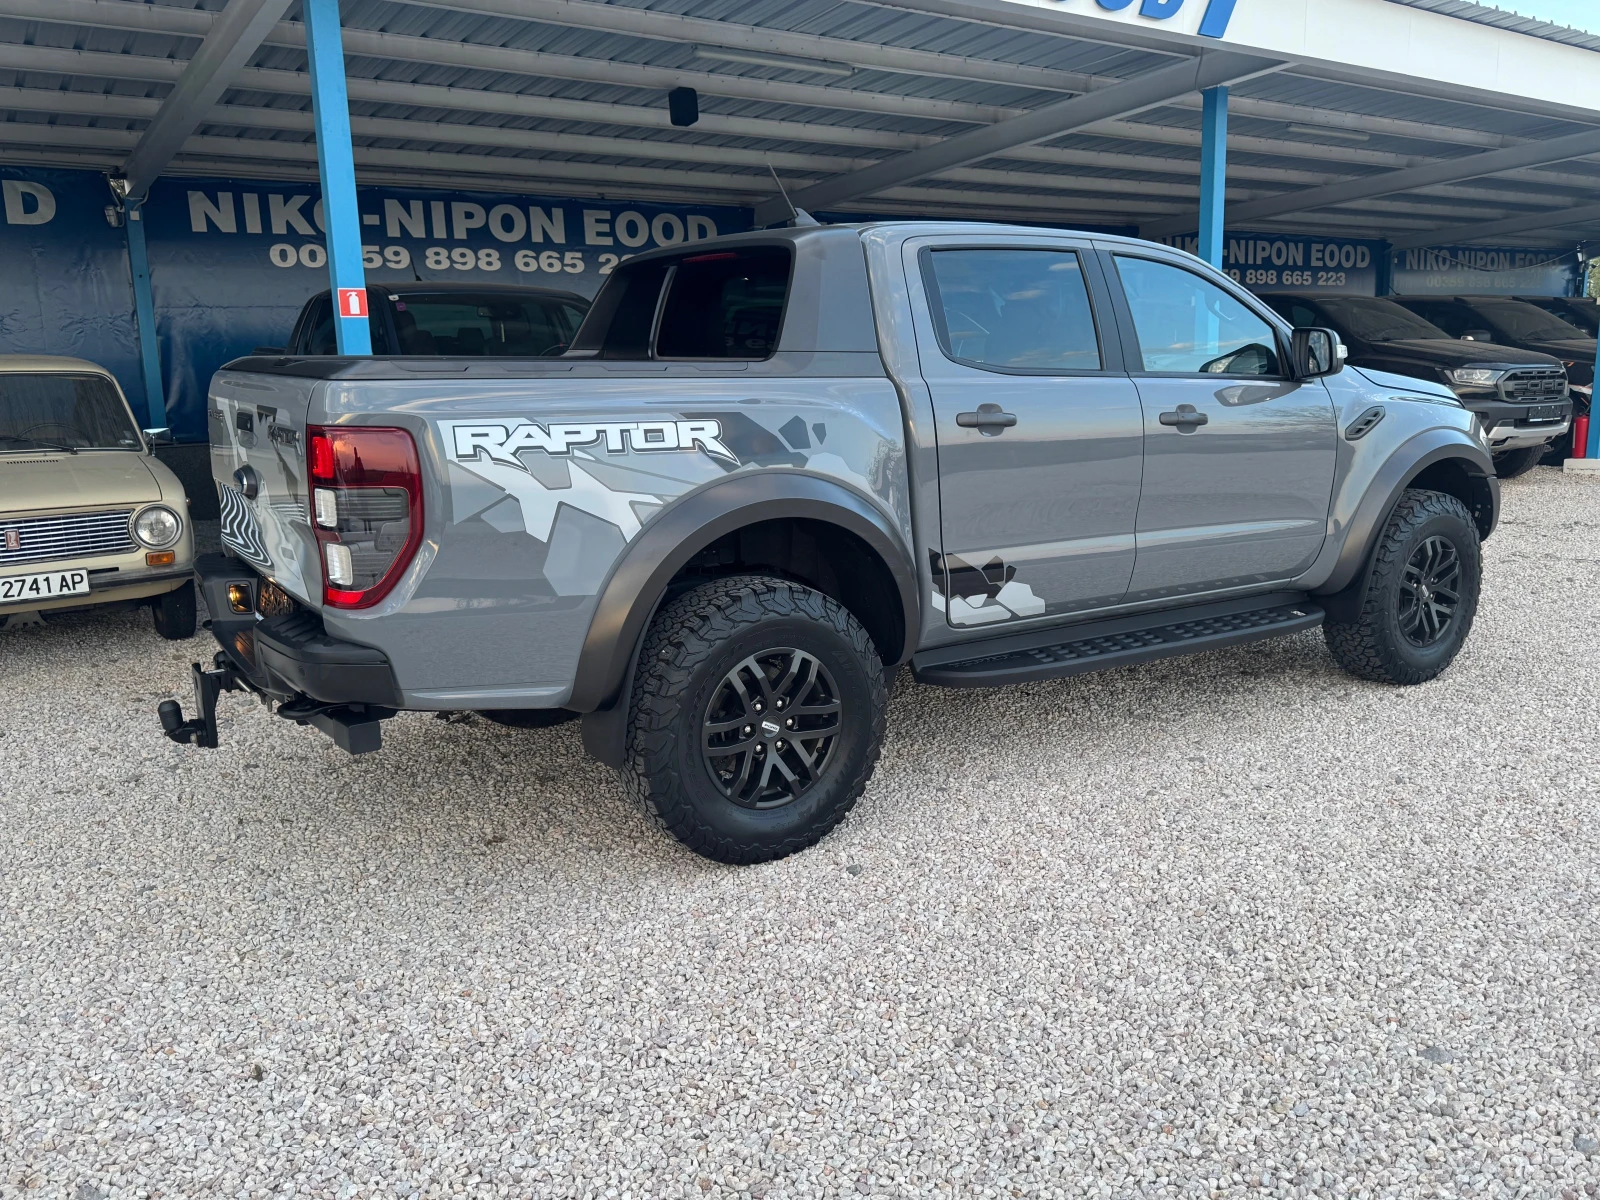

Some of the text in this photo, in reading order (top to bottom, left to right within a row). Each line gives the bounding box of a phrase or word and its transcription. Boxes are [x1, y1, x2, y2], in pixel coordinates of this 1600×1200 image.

[583, 209, 718, 247] EOOD
[269, 244, 411, 269] 0059
[425, 247, 502, 271] 898
[514, 250, 585, 273] 665
[1310, 243, 1370, 268] EOOD
[1406, 248, 1510, 272] NIKO-NIPON
[1245, 269, 1277, 284] 898
[1282, 270, 1312, 285] 665
[1317, 271, 1346, 286] 223
[451, 419, 741, 474] RAPTOR
[1, 573, 85, 598] 2741 AP
